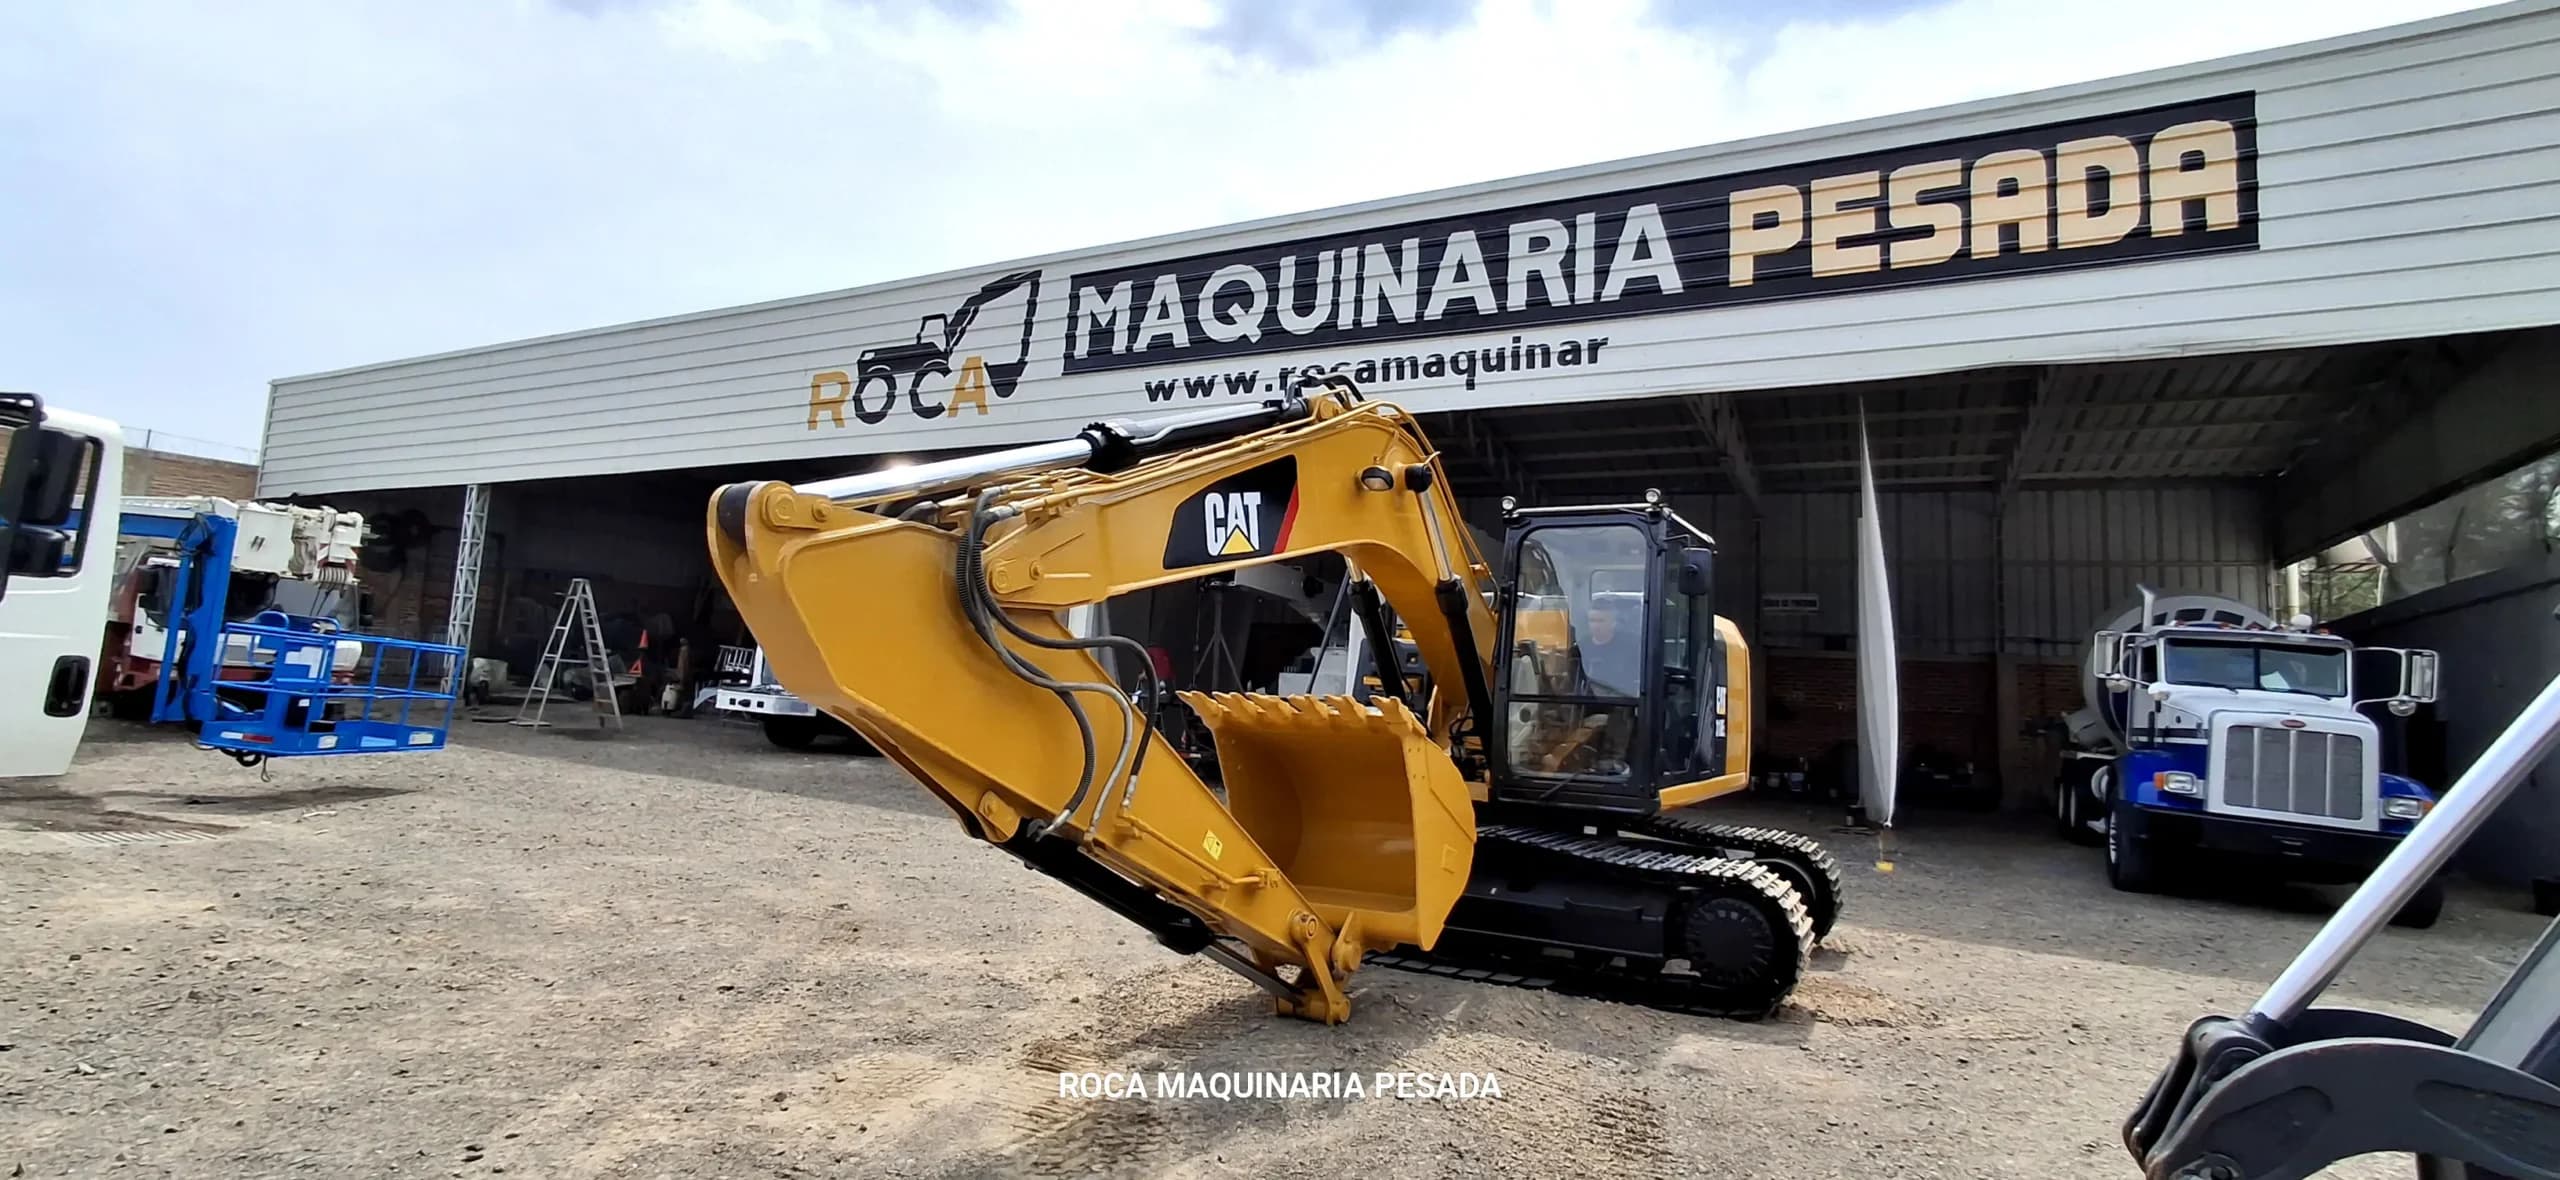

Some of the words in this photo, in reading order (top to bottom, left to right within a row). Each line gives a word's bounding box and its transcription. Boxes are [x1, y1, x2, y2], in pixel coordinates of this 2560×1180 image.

[1075, 203, 1684, 360] MAQUINARIA
[1728, 119, 2239, 287] PESADA
[807, 356, 989, 431] ROCA
[1204, 491, 1261, 557] CAT
